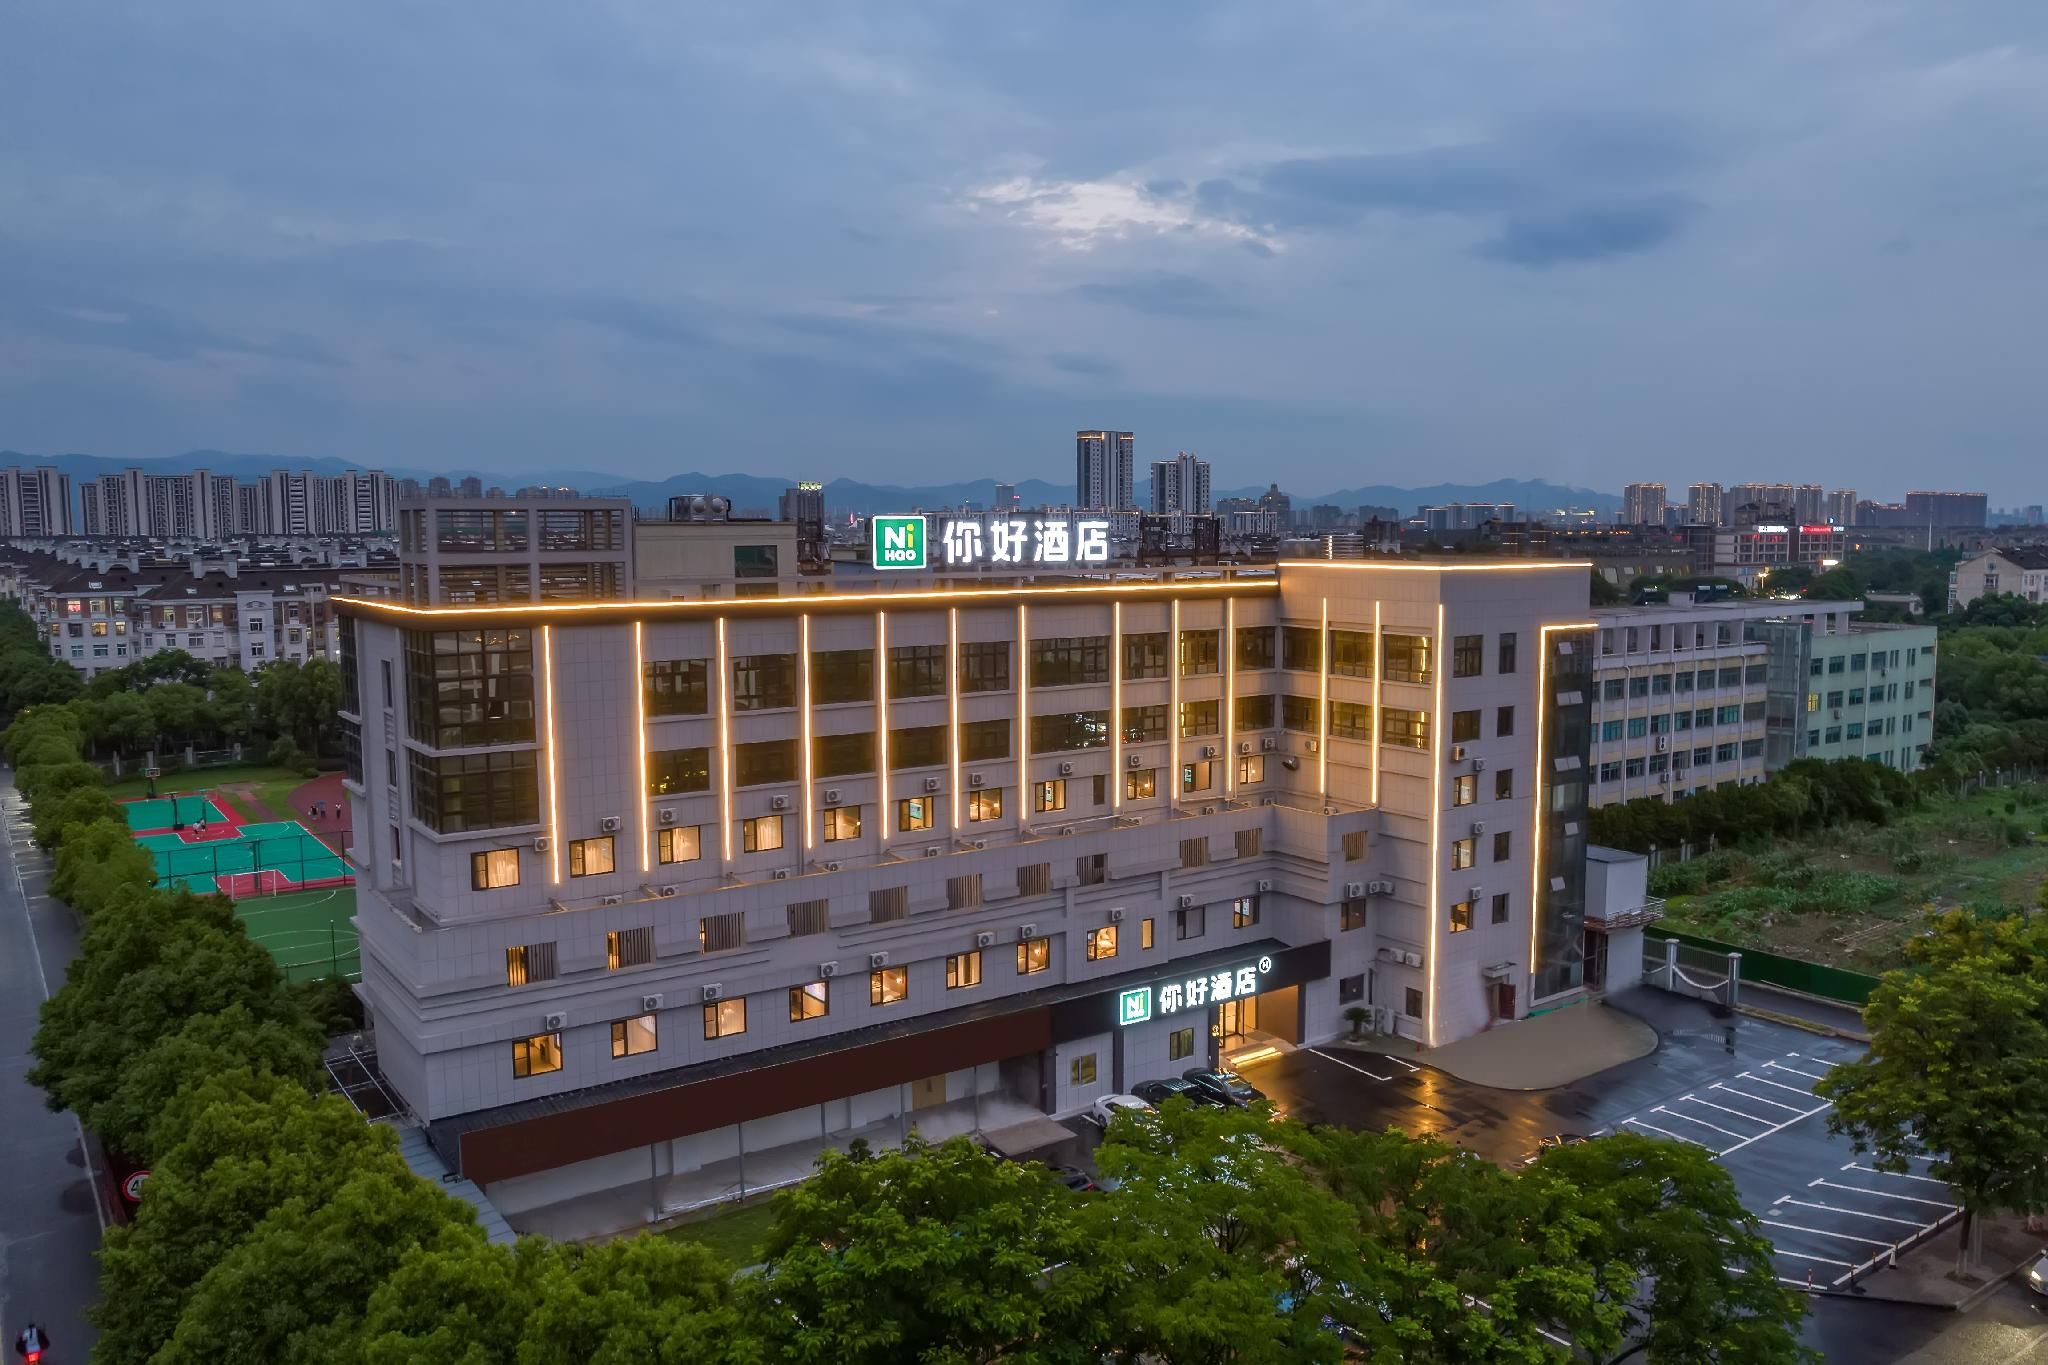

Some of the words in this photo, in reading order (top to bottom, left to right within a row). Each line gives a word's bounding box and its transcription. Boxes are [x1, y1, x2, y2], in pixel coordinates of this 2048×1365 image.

[884, 524, 914, 549] Ni
[943, 521, 1108, 563] 你好酒店
[1160, 967, 1257, 1014] 你好酒店
